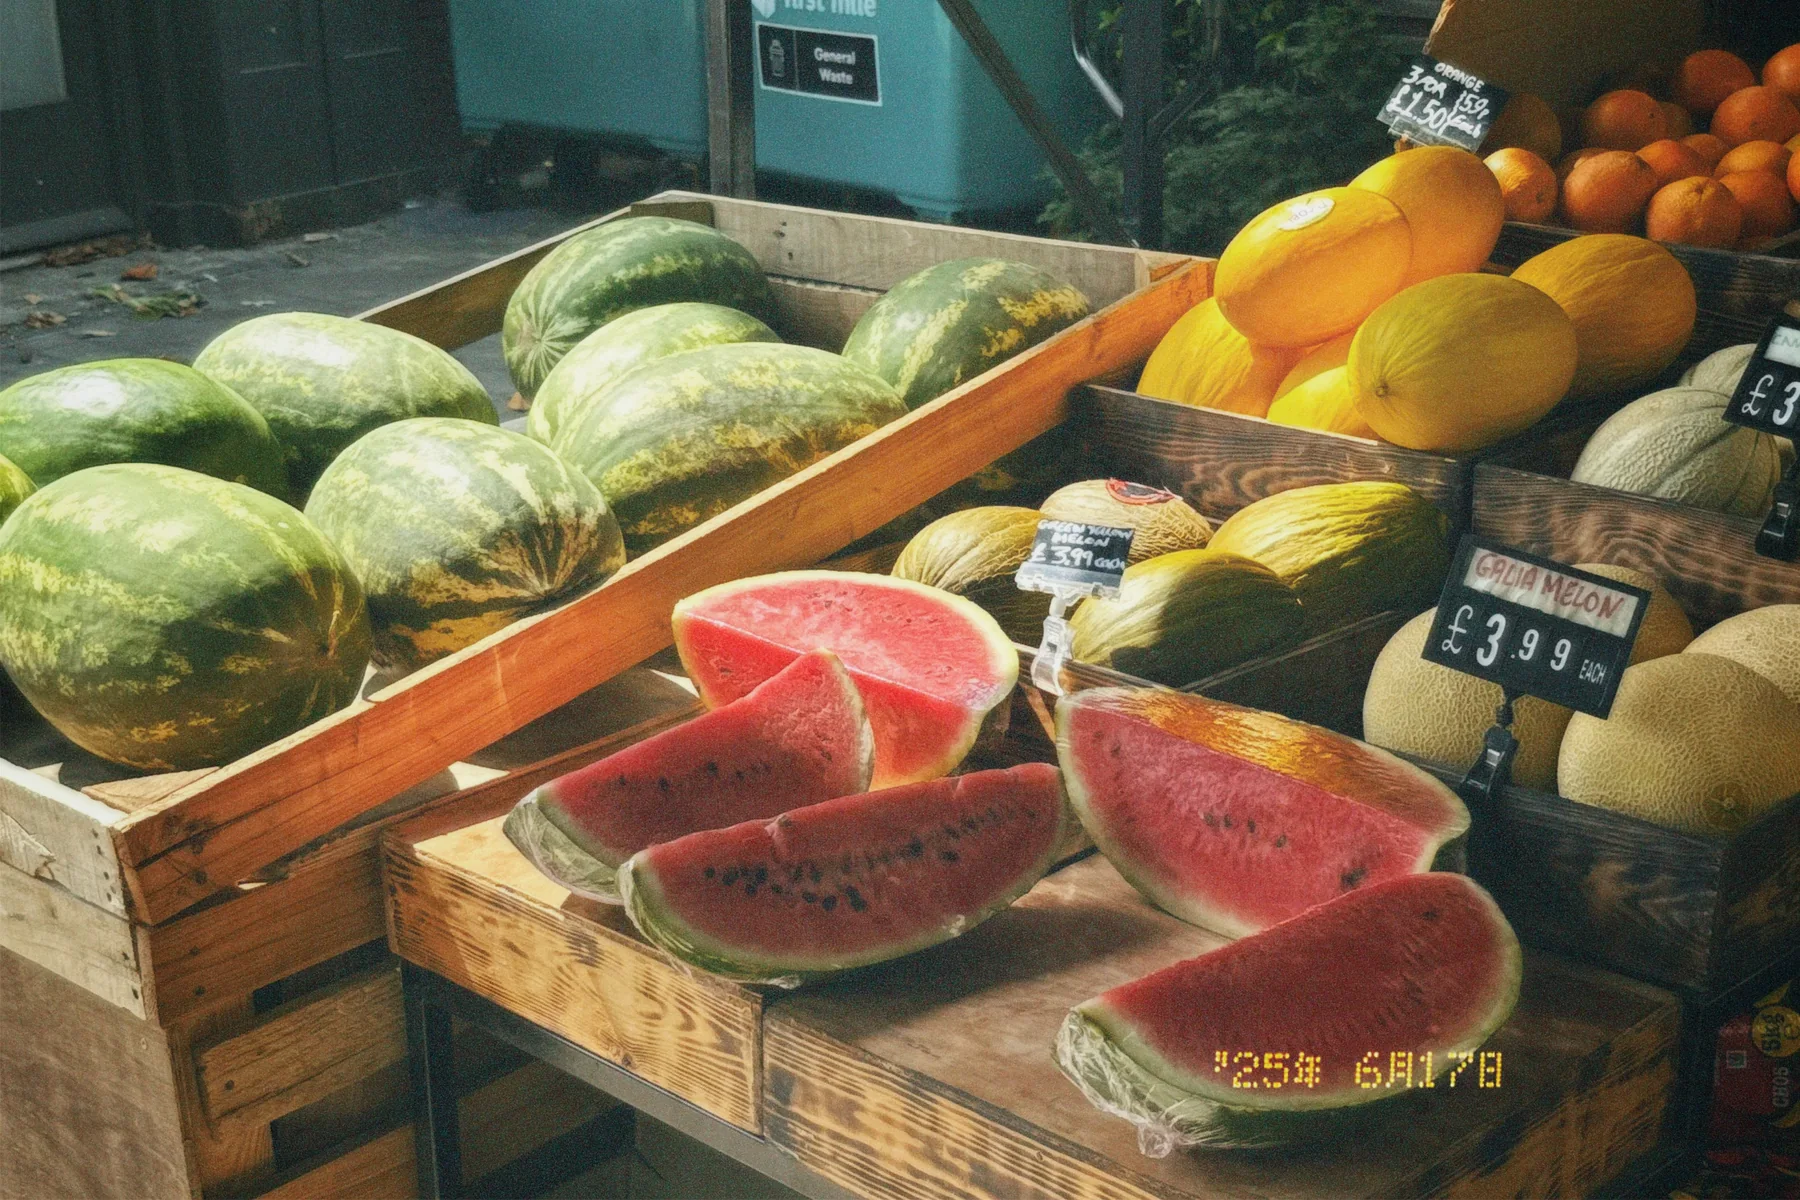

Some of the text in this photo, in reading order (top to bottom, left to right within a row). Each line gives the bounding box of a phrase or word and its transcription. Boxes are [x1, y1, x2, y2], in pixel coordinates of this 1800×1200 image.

[814, 47, 856, 66] General
[818, 68, 853, 85] Waste
[1402, 64, 1424, 84] 3
[1434, 62, 1485, 93] ORANGE
[1386, 84, 1447, 129] £1.50
[1051, 532, 1111, 547] MELON
[1475, 552, 1625, 620] GALIA MELON
[1579, 659, 1607, 685] EACH
